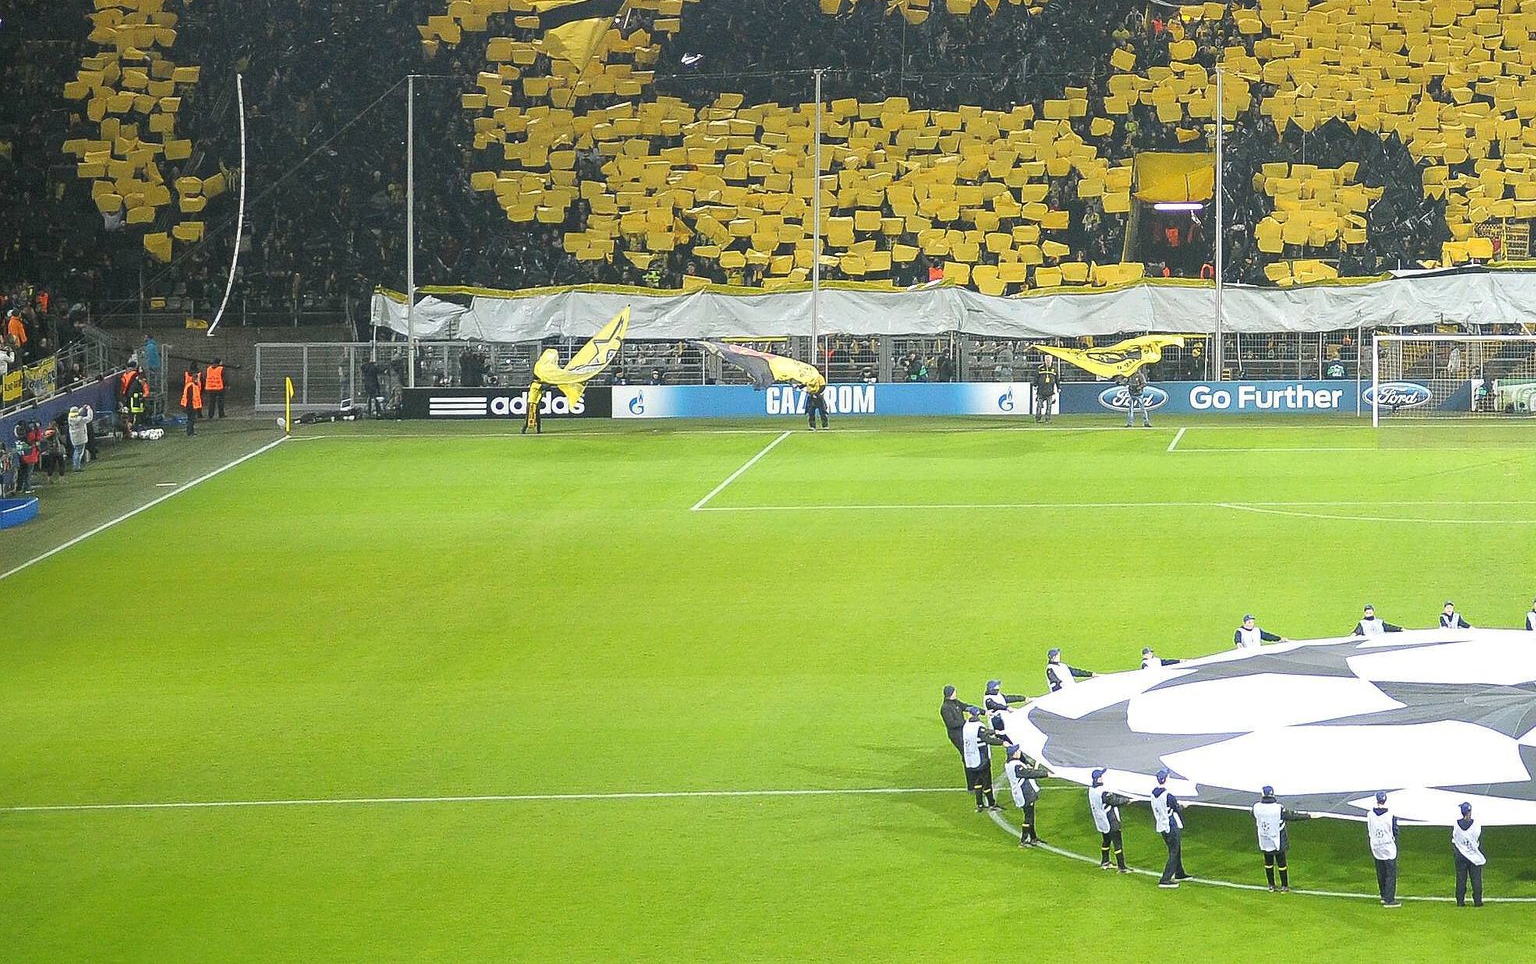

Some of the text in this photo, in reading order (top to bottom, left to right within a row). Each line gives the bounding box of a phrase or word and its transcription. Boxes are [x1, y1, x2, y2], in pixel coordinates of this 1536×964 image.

[491, 392, 585, 415] addas
[766, 386, 875, 414] GAZROM
[1112, 389, 1154, 407] Fod
[1189, 385, 1343, 409] Go Further
[1376, 388, 1418, 404] Ford
